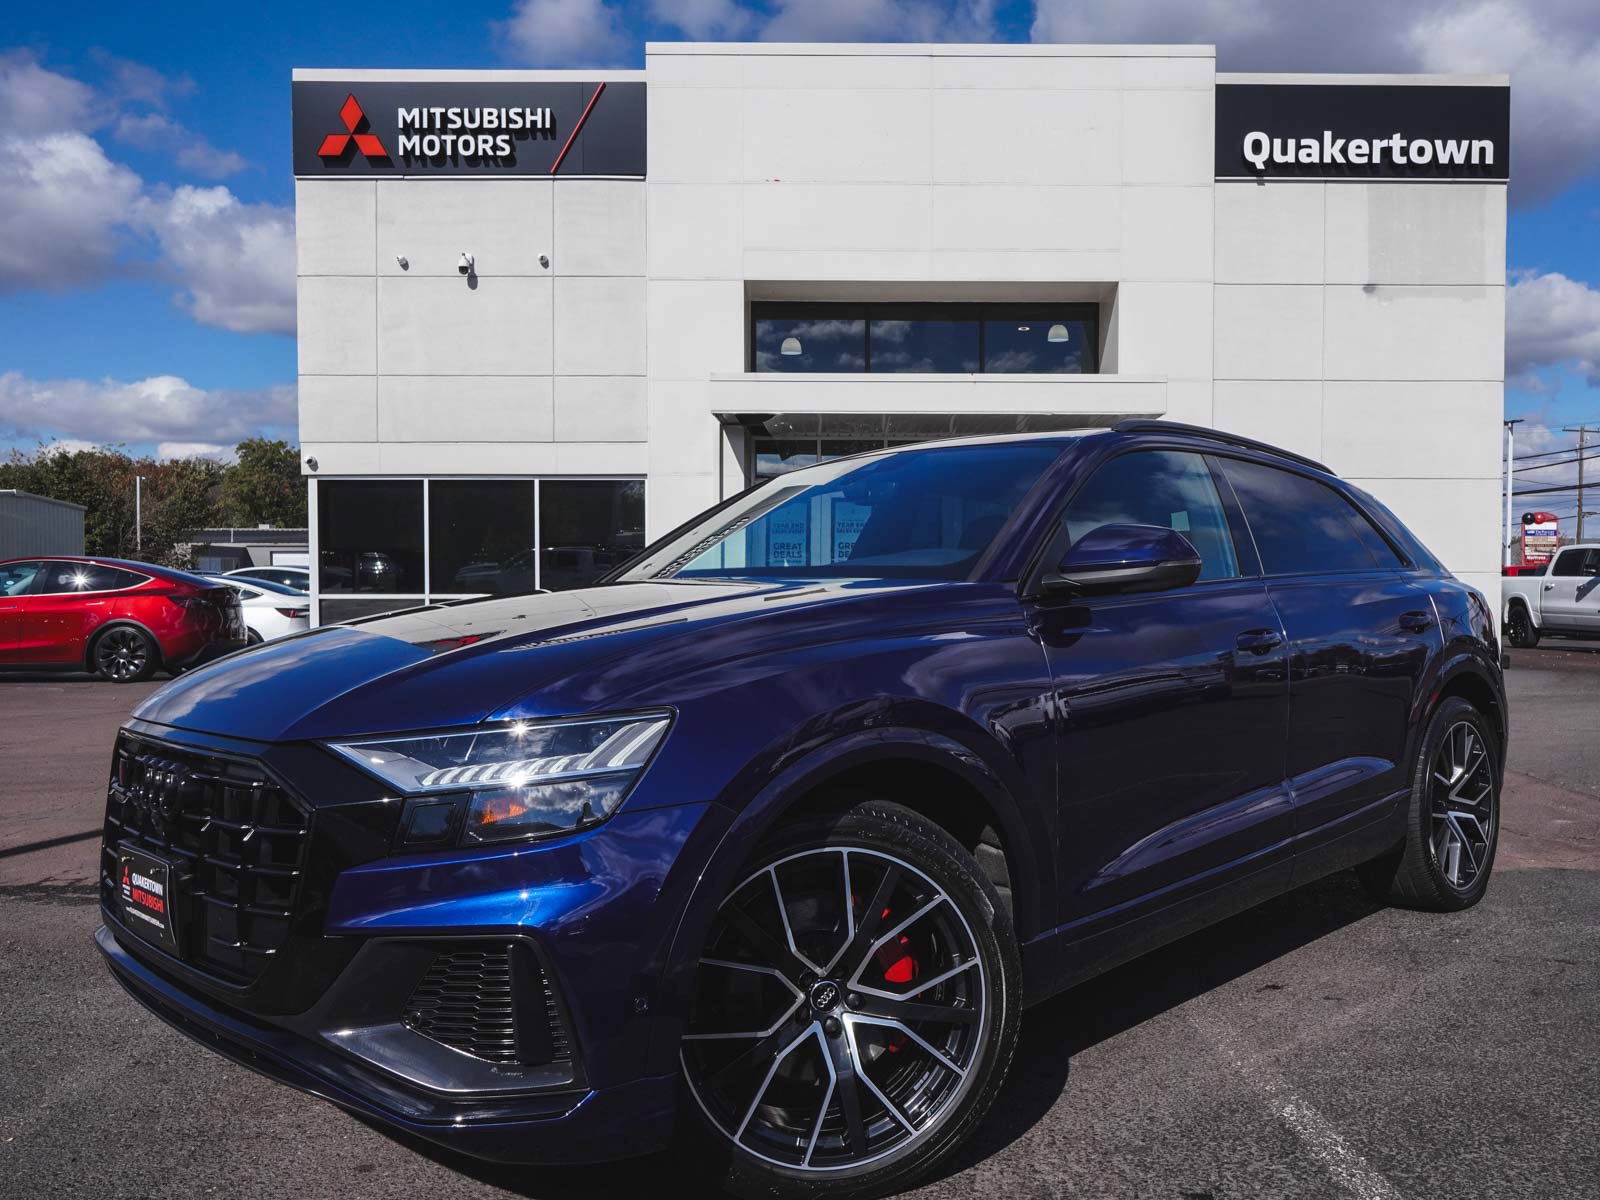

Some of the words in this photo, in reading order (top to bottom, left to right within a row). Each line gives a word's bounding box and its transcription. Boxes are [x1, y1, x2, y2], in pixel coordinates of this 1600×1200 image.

[397, 107, 551, 129] MITSUBISHI
[397, 134, 511, 156] MOTORS
[1243, 130, 1495, 170] Quakertown
[773, 542, 803, 550] GREAT
[131, 872, 164, 897] QUAKERTOWN
[132, 887, 164, 913] MITSUBISHI
